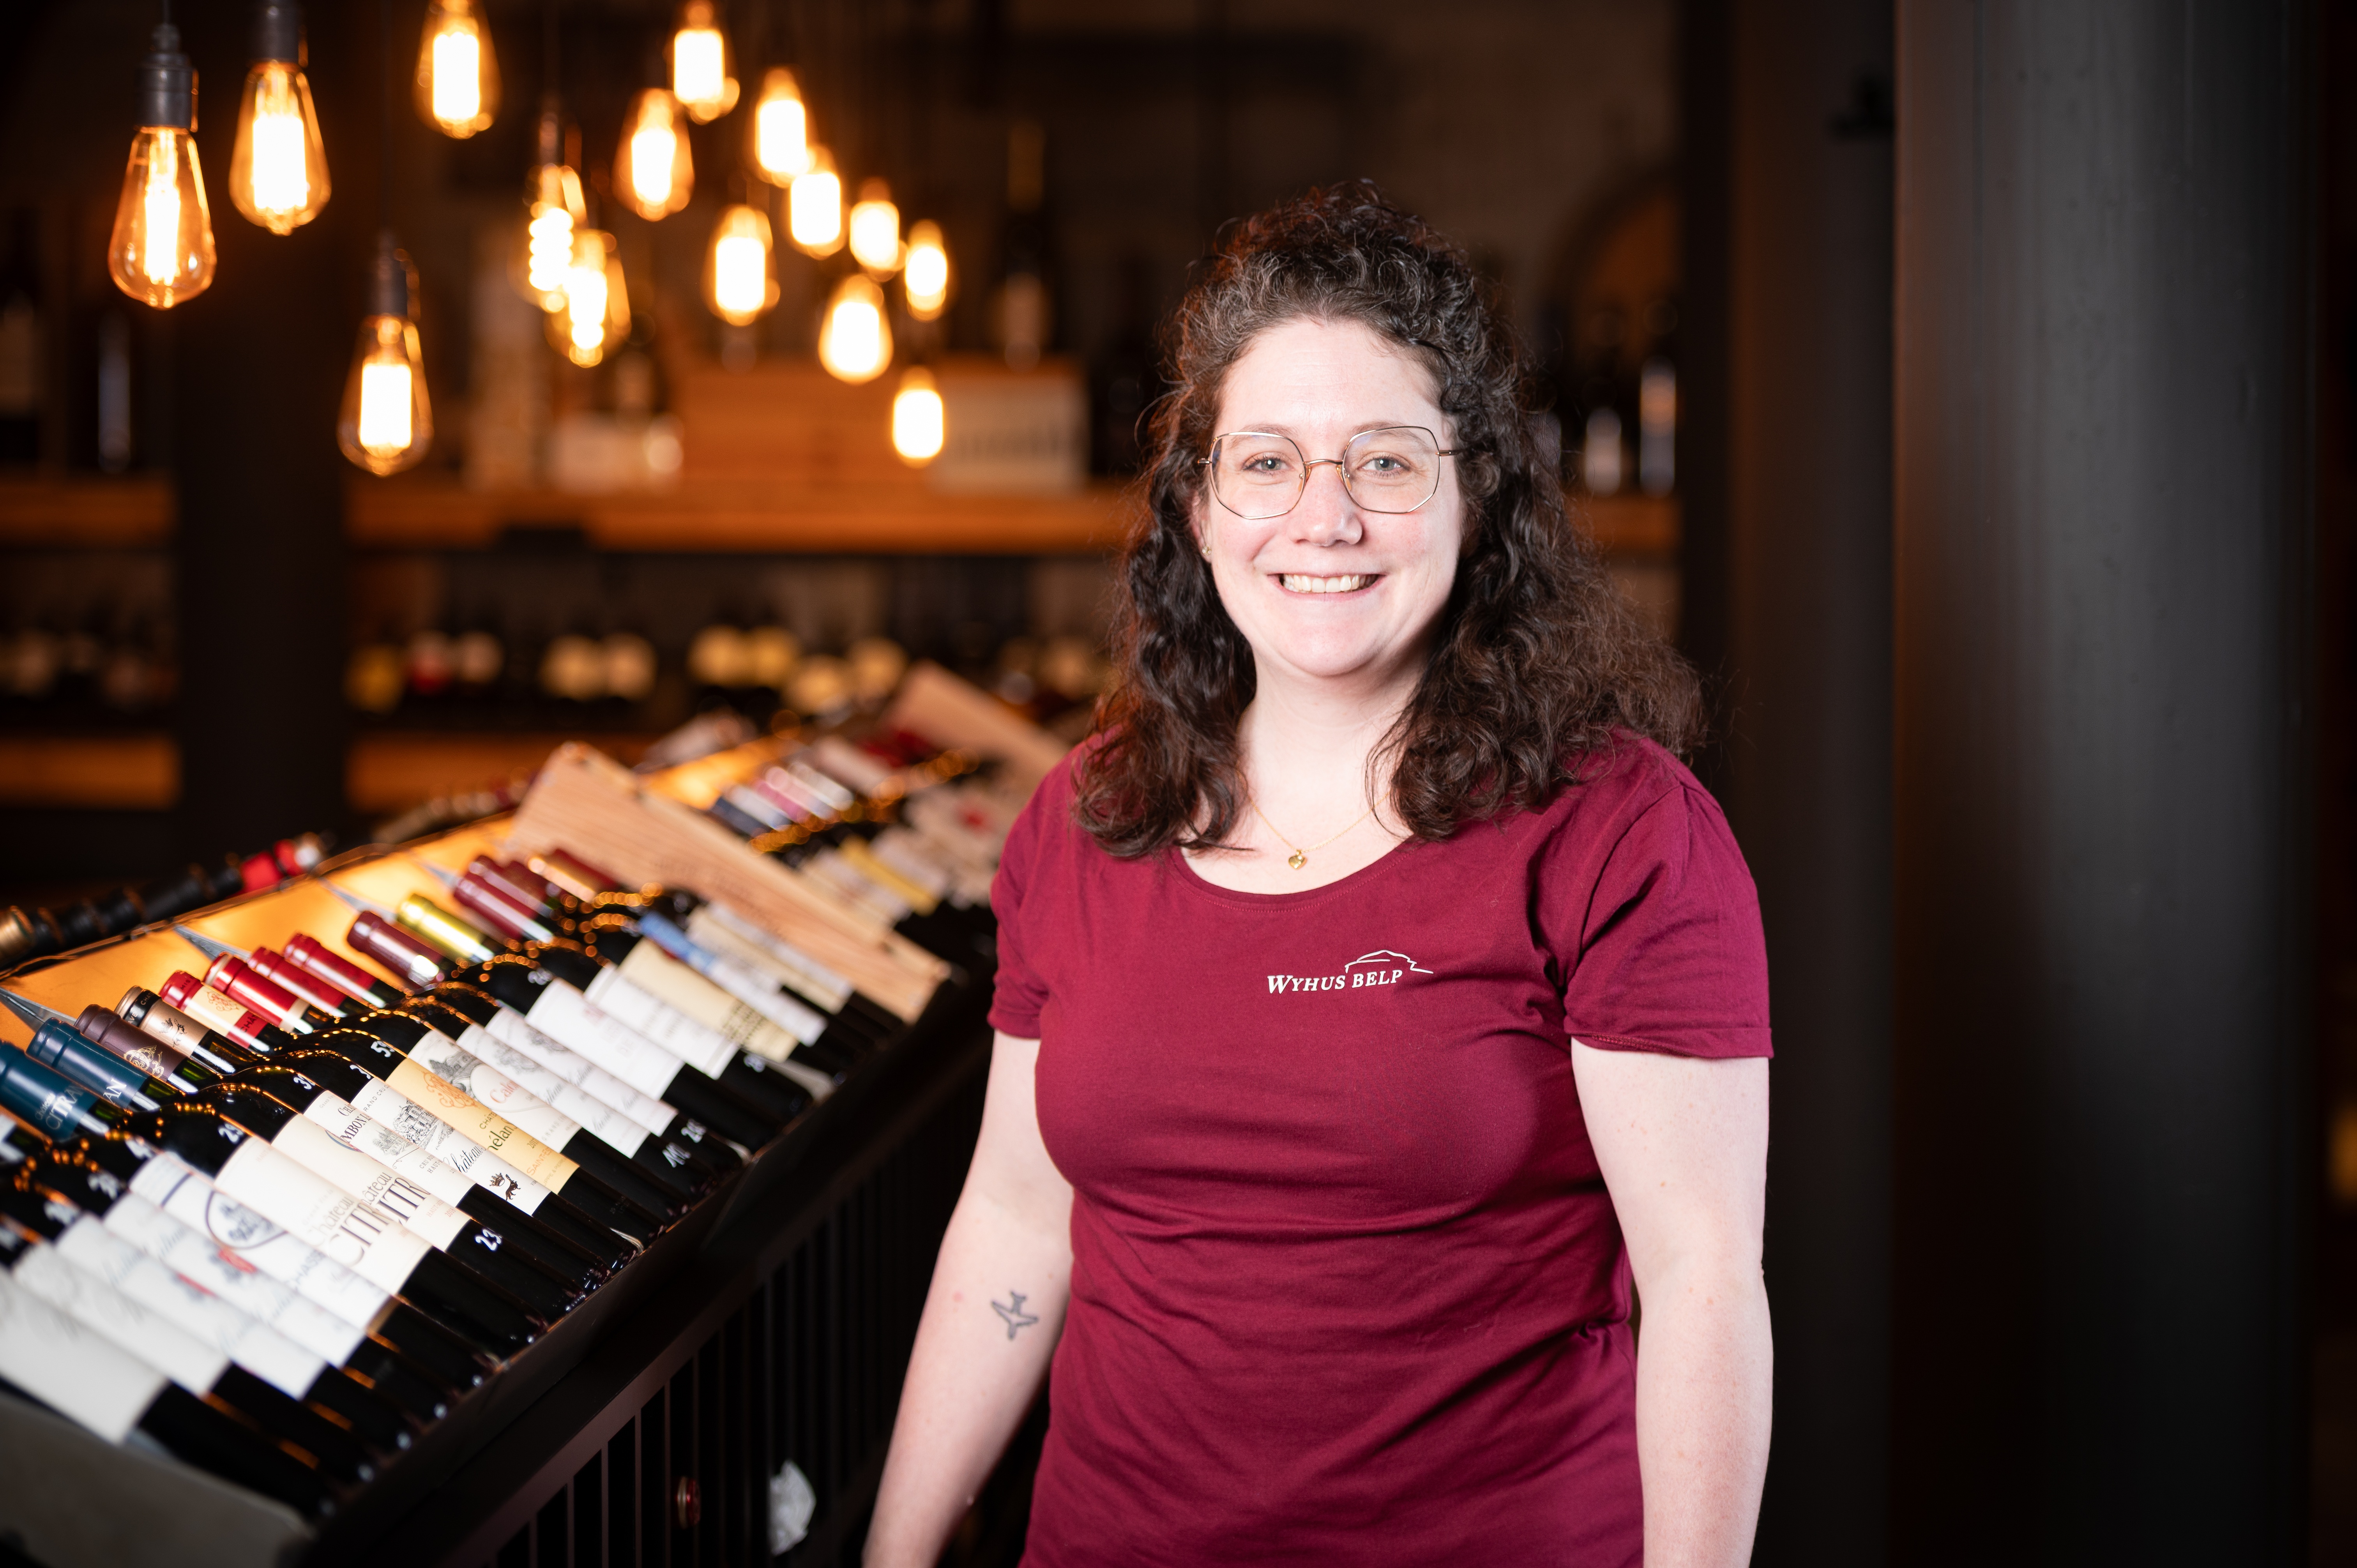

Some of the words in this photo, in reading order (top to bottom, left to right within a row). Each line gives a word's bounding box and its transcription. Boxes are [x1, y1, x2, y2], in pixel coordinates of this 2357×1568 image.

[1267, 975, 1345, 994] WYHUS
[1352, 969, 1403, 989] BELP
[443, 1146, 484, 1173] hâteau
[375, 1177, 431, 1226] ITR
[475, 1227, 503, 1252] 23
